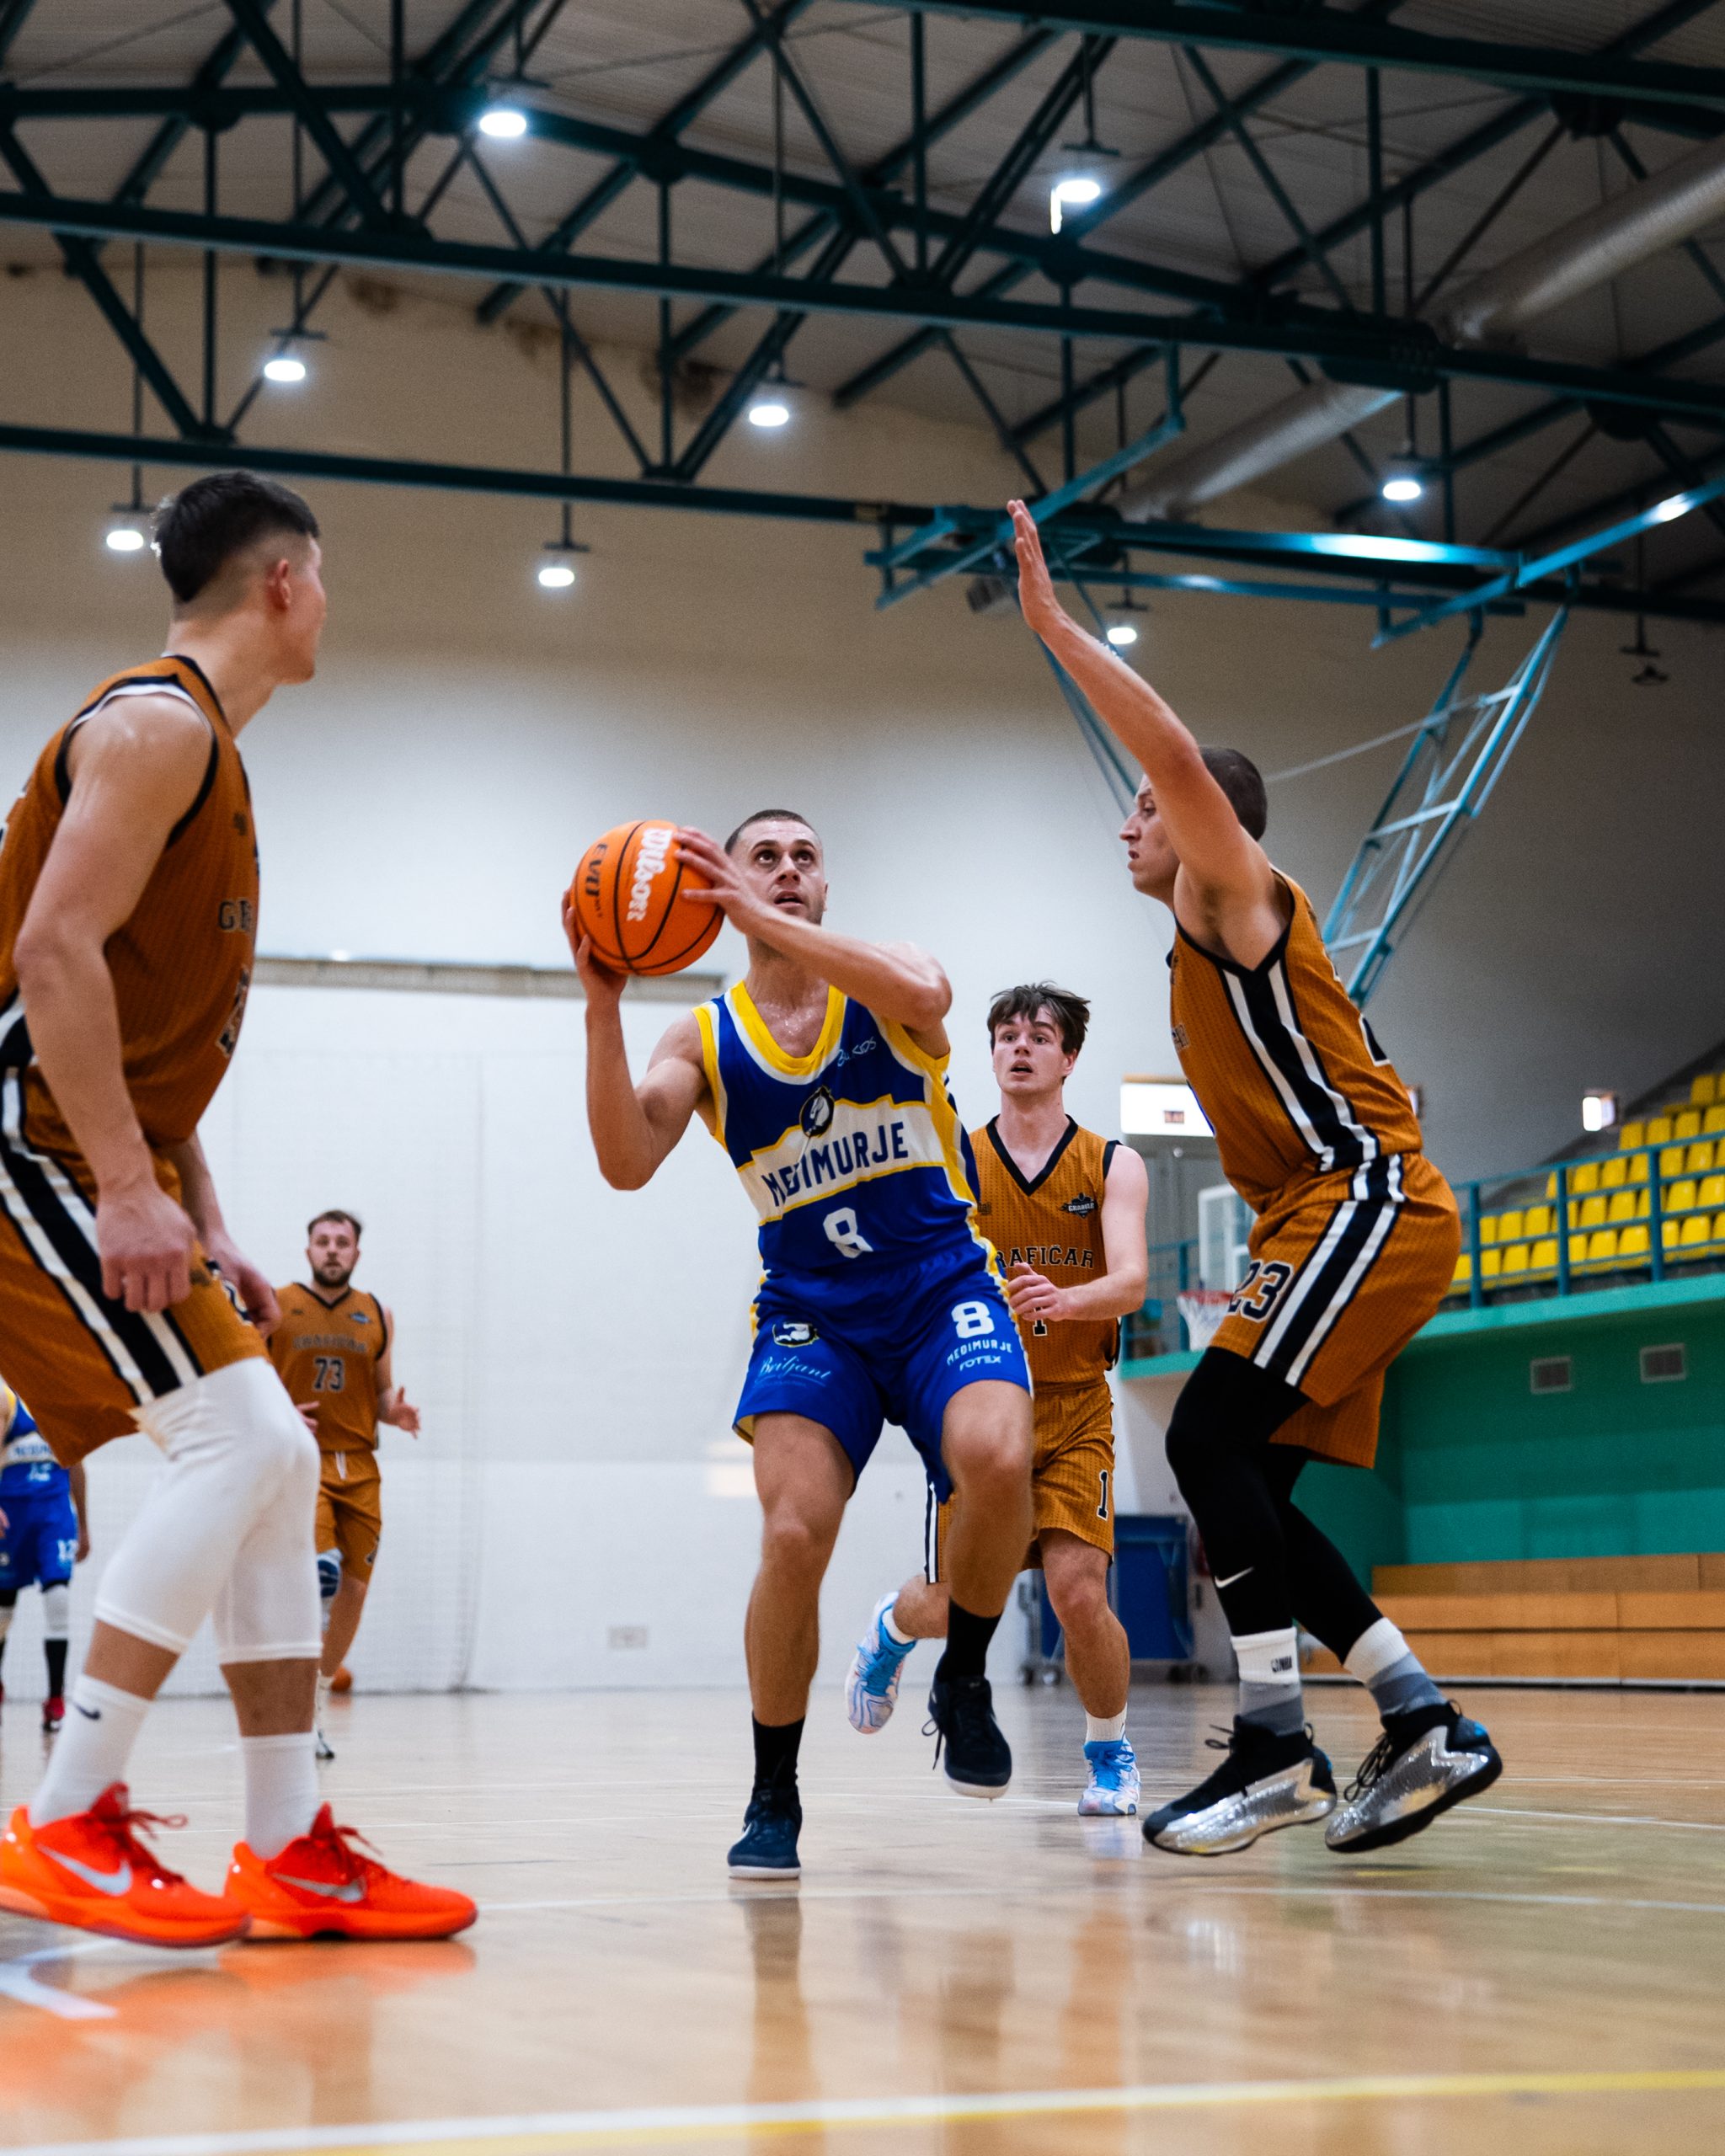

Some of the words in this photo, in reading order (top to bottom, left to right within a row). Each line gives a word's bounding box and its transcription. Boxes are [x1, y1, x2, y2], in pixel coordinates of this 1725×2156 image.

[822, 1206, 873, 1259] 8
[996, 1244, 1094, 1269] RAFIČAR
[1227, 1258, 1295, 1323] 23
[951, 1300, 995, 1338] 8
[312, 1356, 345, 1392] 73
[1097, 1470, 1109, 1522] 1
